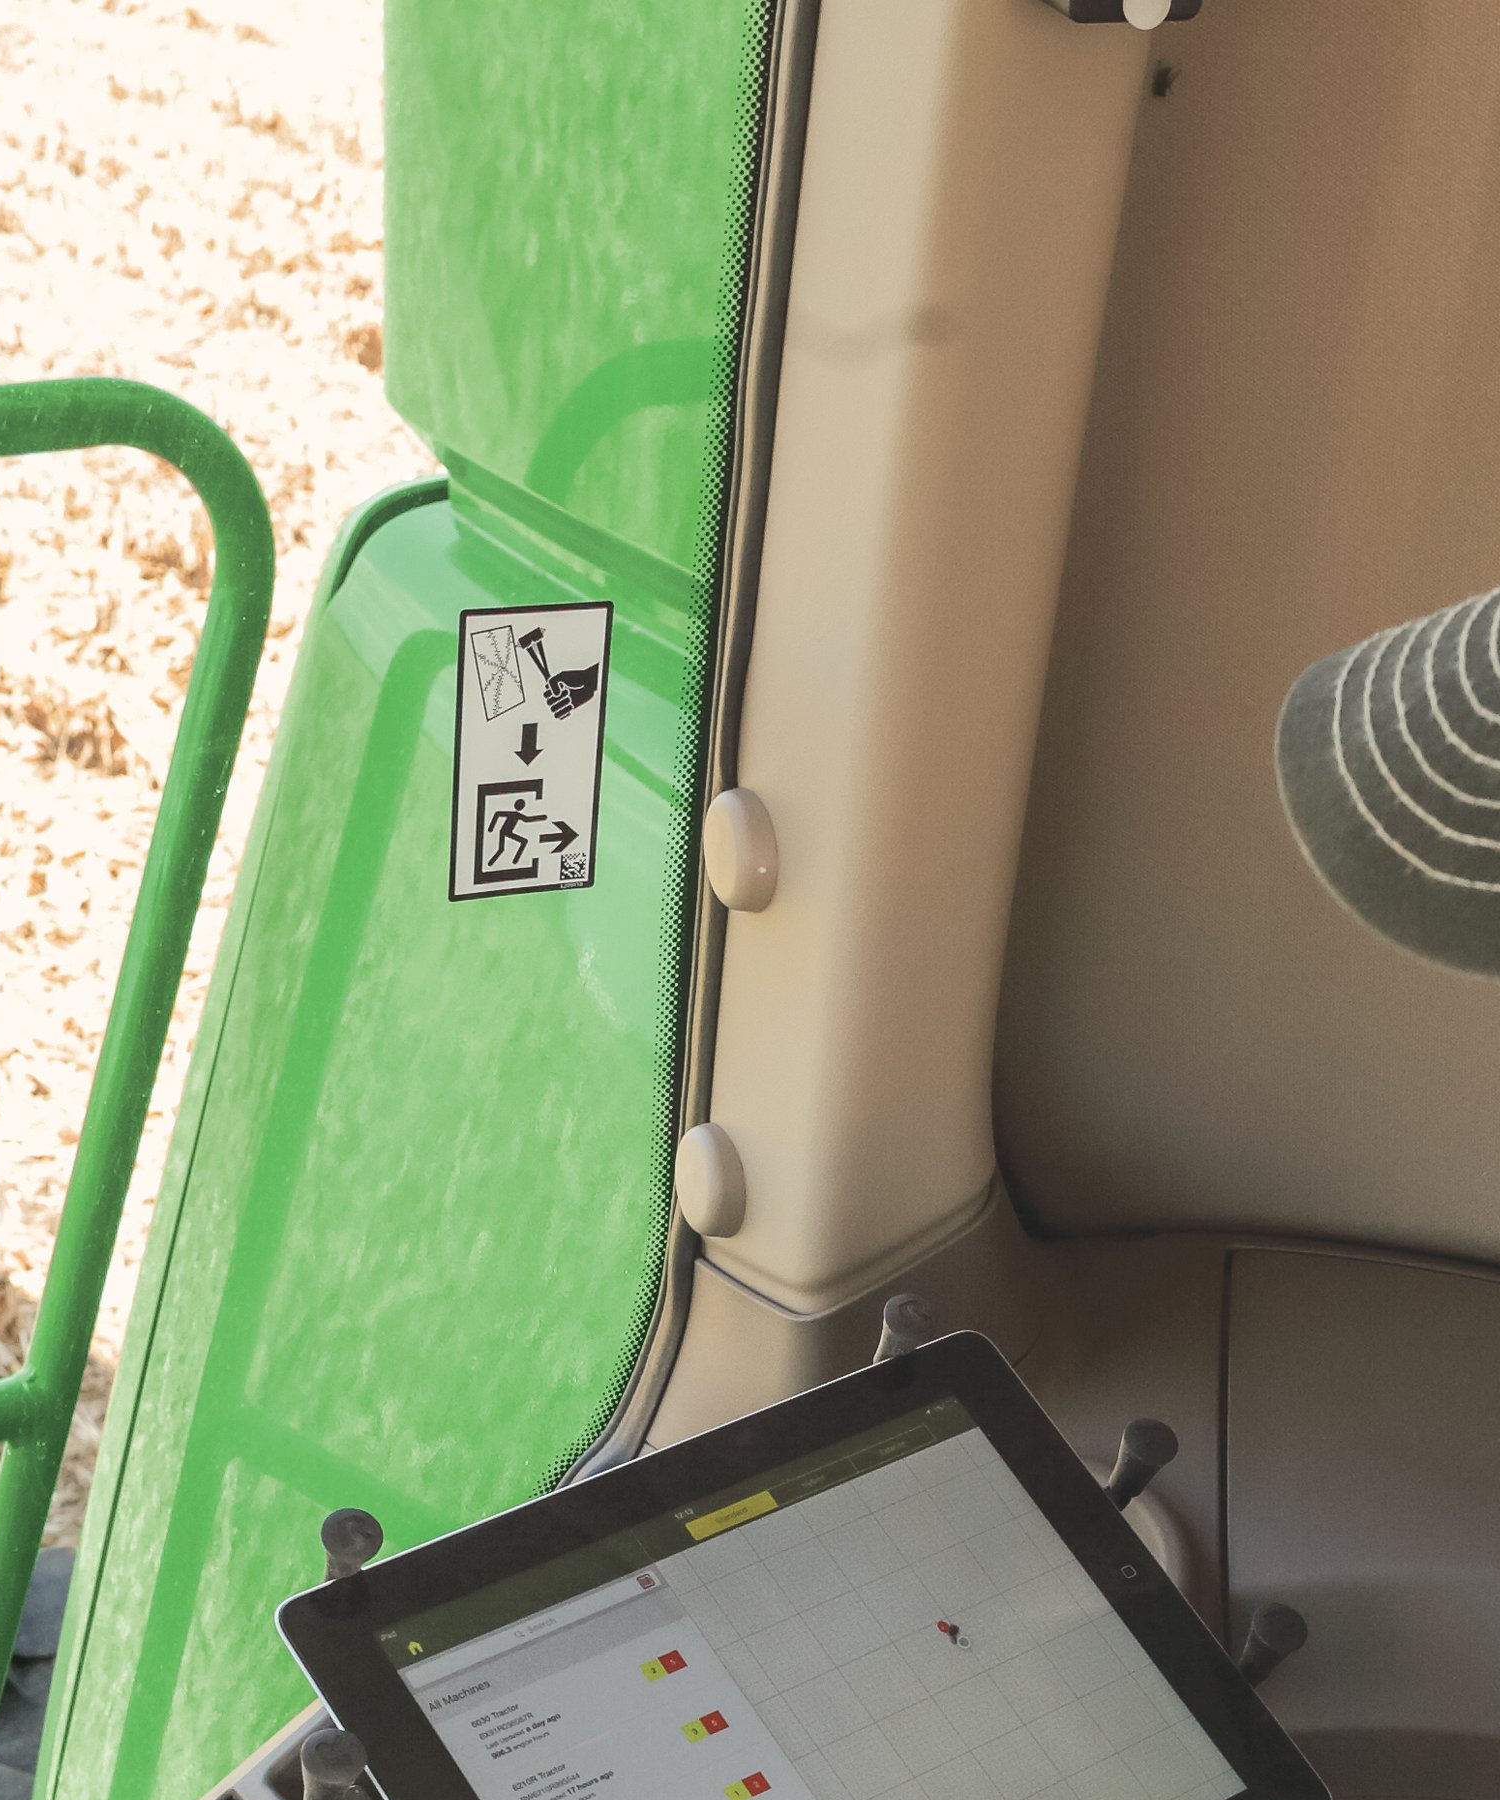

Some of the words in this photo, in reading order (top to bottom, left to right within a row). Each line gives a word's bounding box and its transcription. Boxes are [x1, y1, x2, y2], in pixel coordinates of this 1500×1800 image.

[426, 1698, 444, 1712] All
[440, 1678, 492, 1707] Machines
[469, 1714, 492, 1728] 6030
[490, 1702, 520, 1719] Tractor
[530, 1718, 547, 1730] day
[545, 1713, 562, 1724] ago
[511, 1774, 539, 1791] 6210R
[537, 1762, 567, 1780] Tractor
[566, 1786, 577, 1795] 17
[575, 1776, 599, 1791] hours
[598, 1769, 616, 1782] ago
